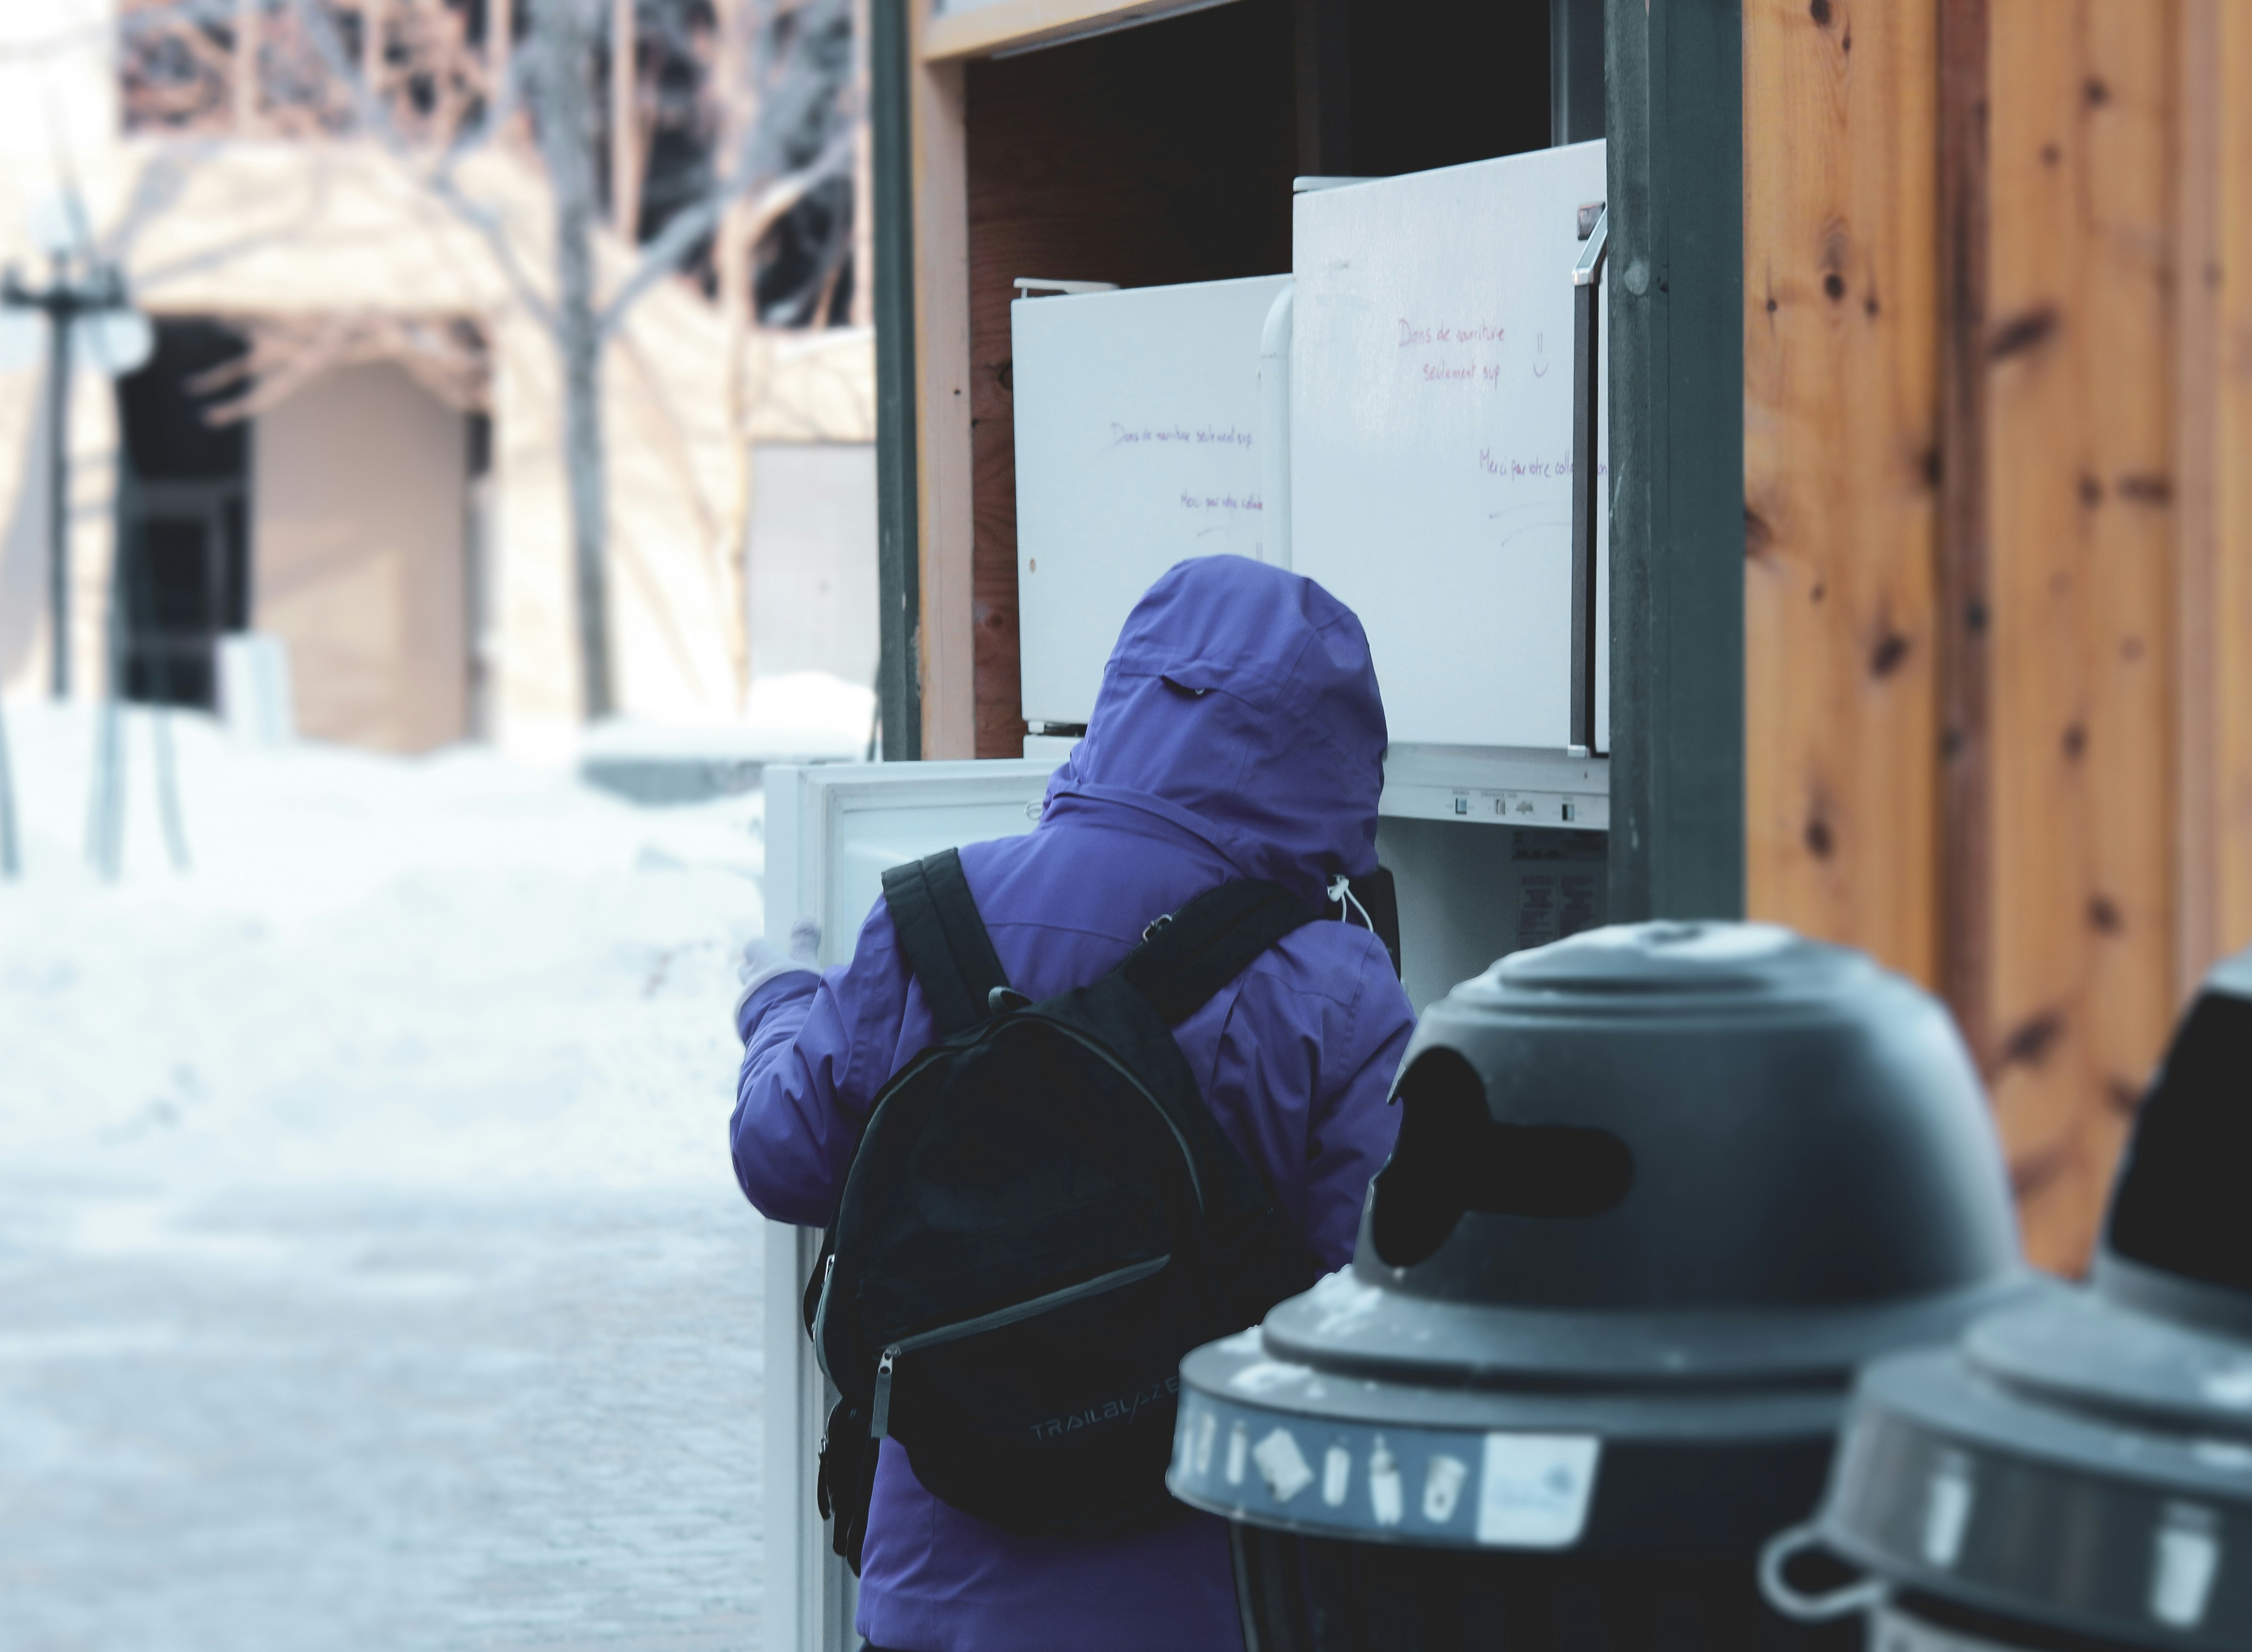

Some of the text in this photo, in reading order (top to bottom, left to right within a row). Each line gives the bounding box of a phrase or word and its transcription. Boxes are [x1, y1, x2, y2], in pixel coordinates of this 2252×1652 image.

[1398, 317, 1431, 348] Dons
[1436, 318, 1450, 341] de
[1423, 357, 1477, 381] seulement
[1110, 421, 1139, 447] Dons
[1479, 446, 1507, 476] Merci
[1030, 1373, 1180, 1442] TRAILBLAZE
